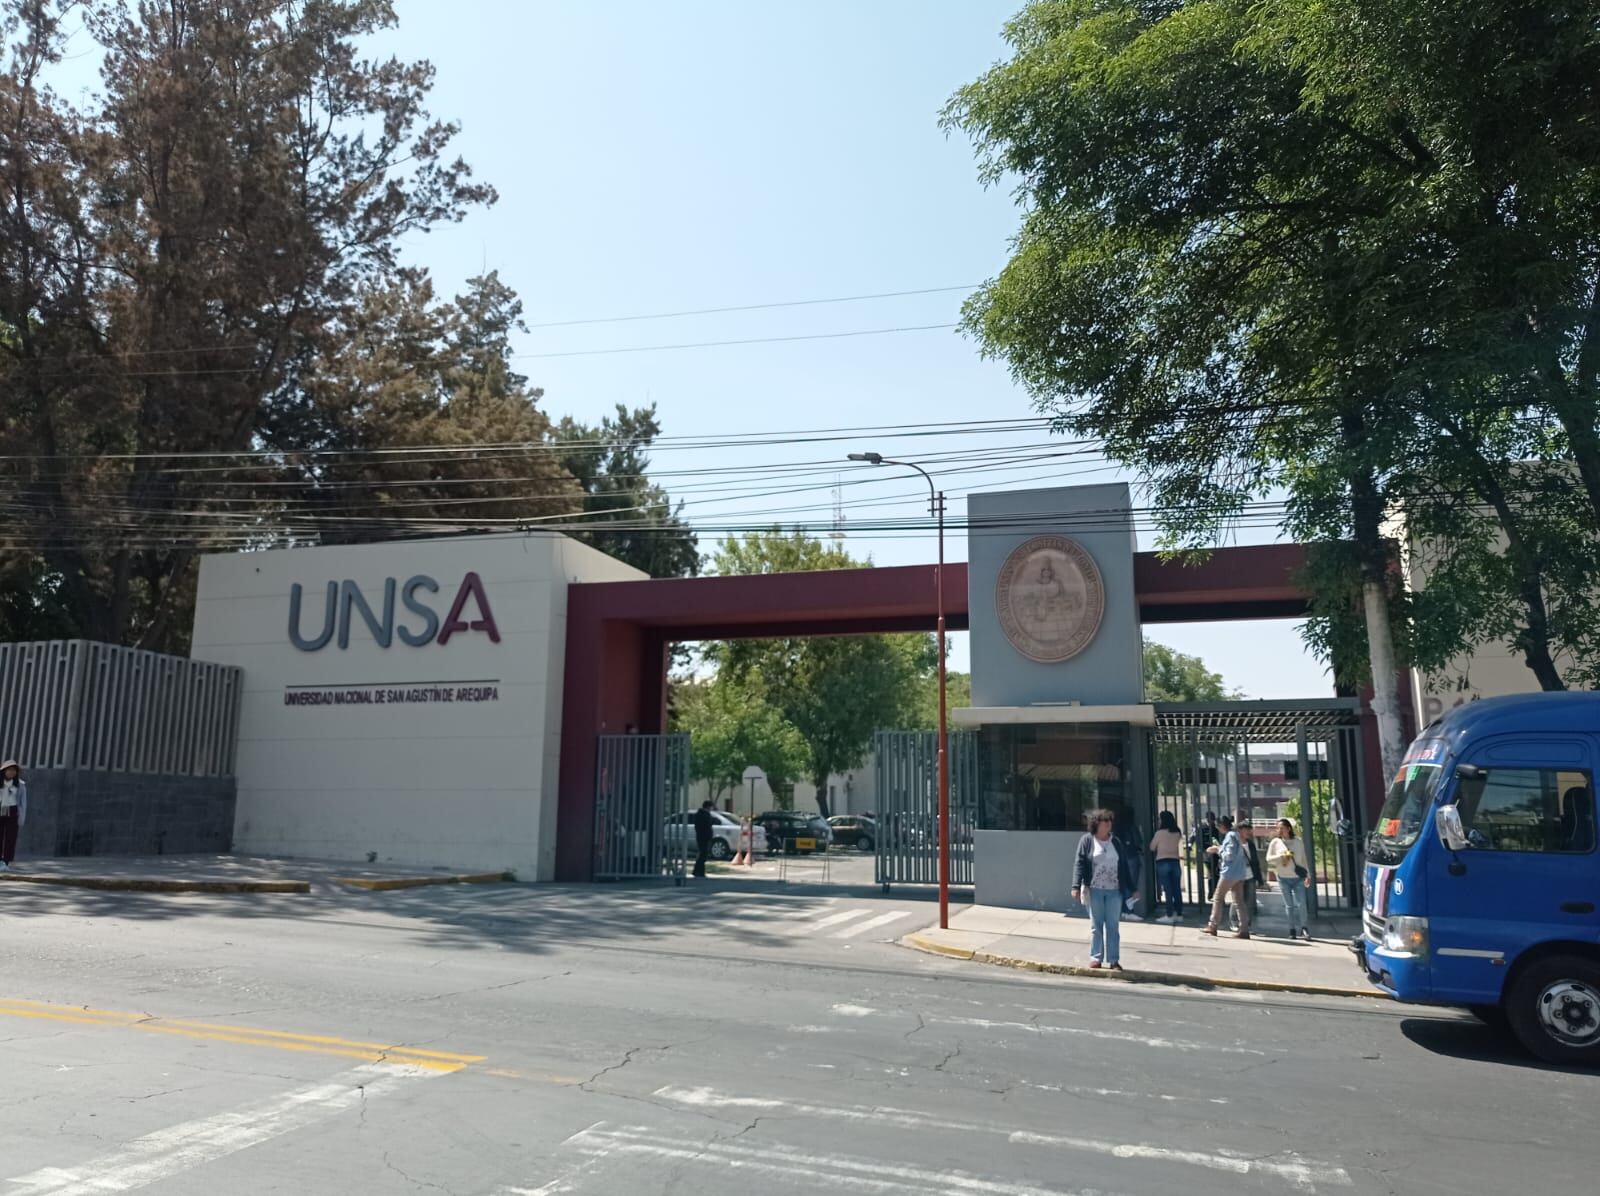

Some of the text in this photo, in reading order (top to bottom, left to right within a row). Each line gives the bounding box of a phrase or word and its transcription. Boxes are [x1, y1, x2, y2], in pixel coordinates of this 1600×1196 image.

[288, 572, 501, 652] UNSA
[284, 692, 334, 706] UNIVERSIDAD
[334, 691, 374, 705] NACIONAL
[374, 689, 386, 704] DE
[386, 688, 404, 703] SAN
[442, 688, 455, 702] DE
[455, 687, 499, 702] AREQUIPA
